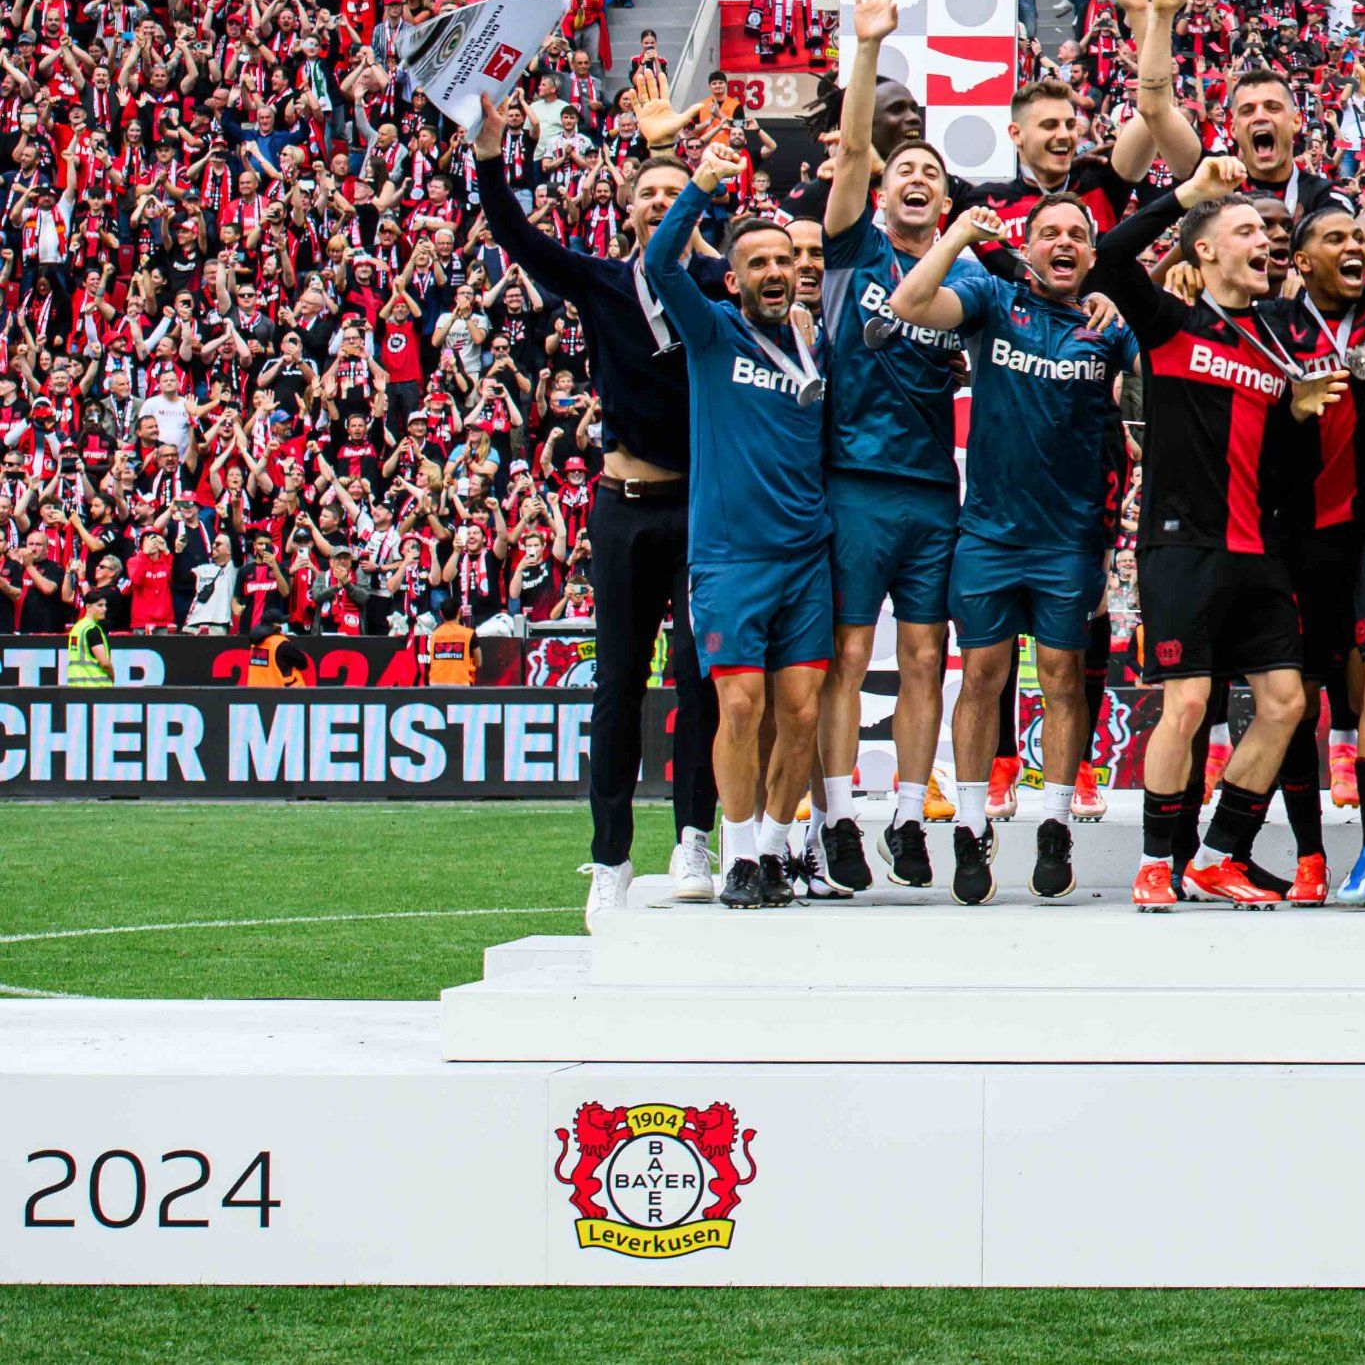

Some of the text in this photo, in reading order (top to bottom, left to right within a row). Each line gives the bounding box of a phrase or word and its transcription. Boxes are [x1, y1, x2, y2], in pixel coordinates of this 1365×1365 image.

[992, 338, 1107, 381] Barmenia
[632, 1111, 678, 1128] 1904
[25, 1149, 281, 1229] 2024
[615, 1174, 696, 1189] BAYER
[647, 1141, 663, 1222] BAYER
[589, 1224, 720, 1253] Leverkusen
